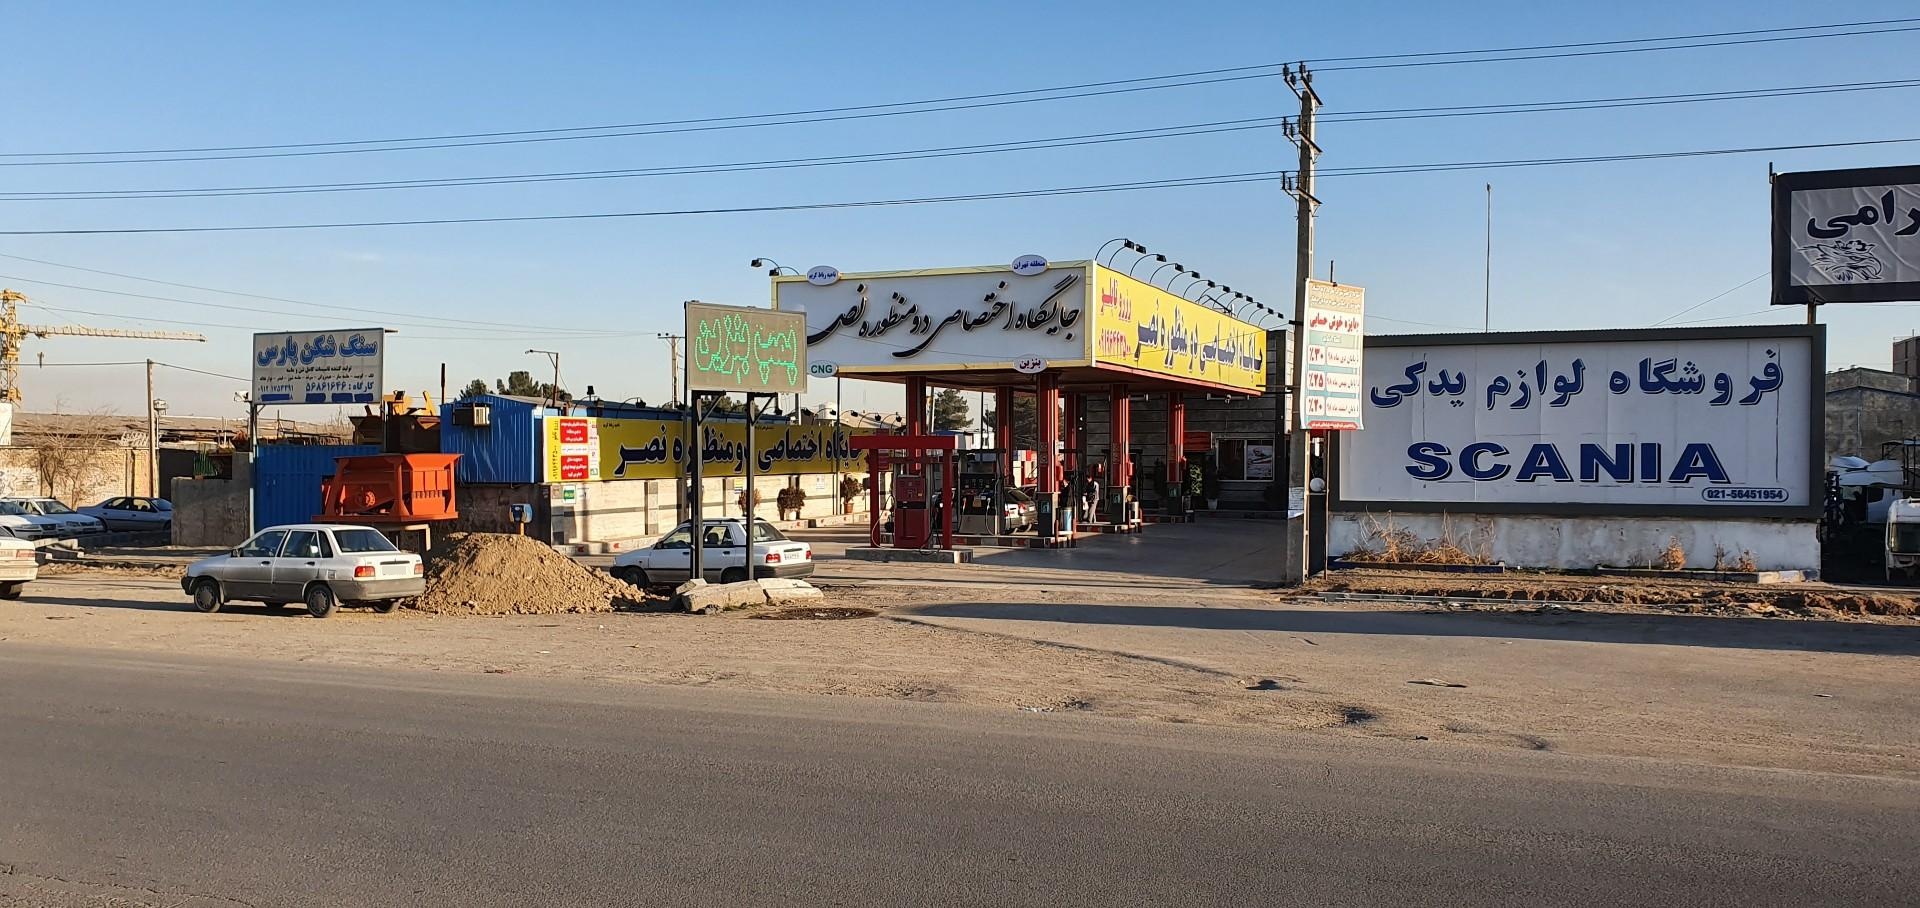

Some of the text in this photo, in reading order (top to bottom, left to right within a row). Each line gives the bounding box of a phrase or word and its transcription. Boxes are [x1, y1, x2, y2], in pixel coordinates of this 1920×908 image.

[891, 281, 1015, 358] اختصاصی
[1013, 273, 1080, 341] جایگاه
[1309, 312, 1328, 328] حسابی
[1328, 314, 1343, 331] خوش
[256, 335, 299, 367] پارس
[299, 334, 337, 366] شکن
[694, 312, 799, 386] پمپ بنزین
[1019, 357, 1041, 370] بنزین
[810, 364, 833, 374] CNG
[1370, 348, 1784, 411] فروشگاه لوازم یدکی
[614, 424, 667, 477] نصر
[757, 428, 823, 473] اختصاصی
[1404, 442, 1731, 484] SCANIA
[1707, 489, 1784, 500] 021-56451954
